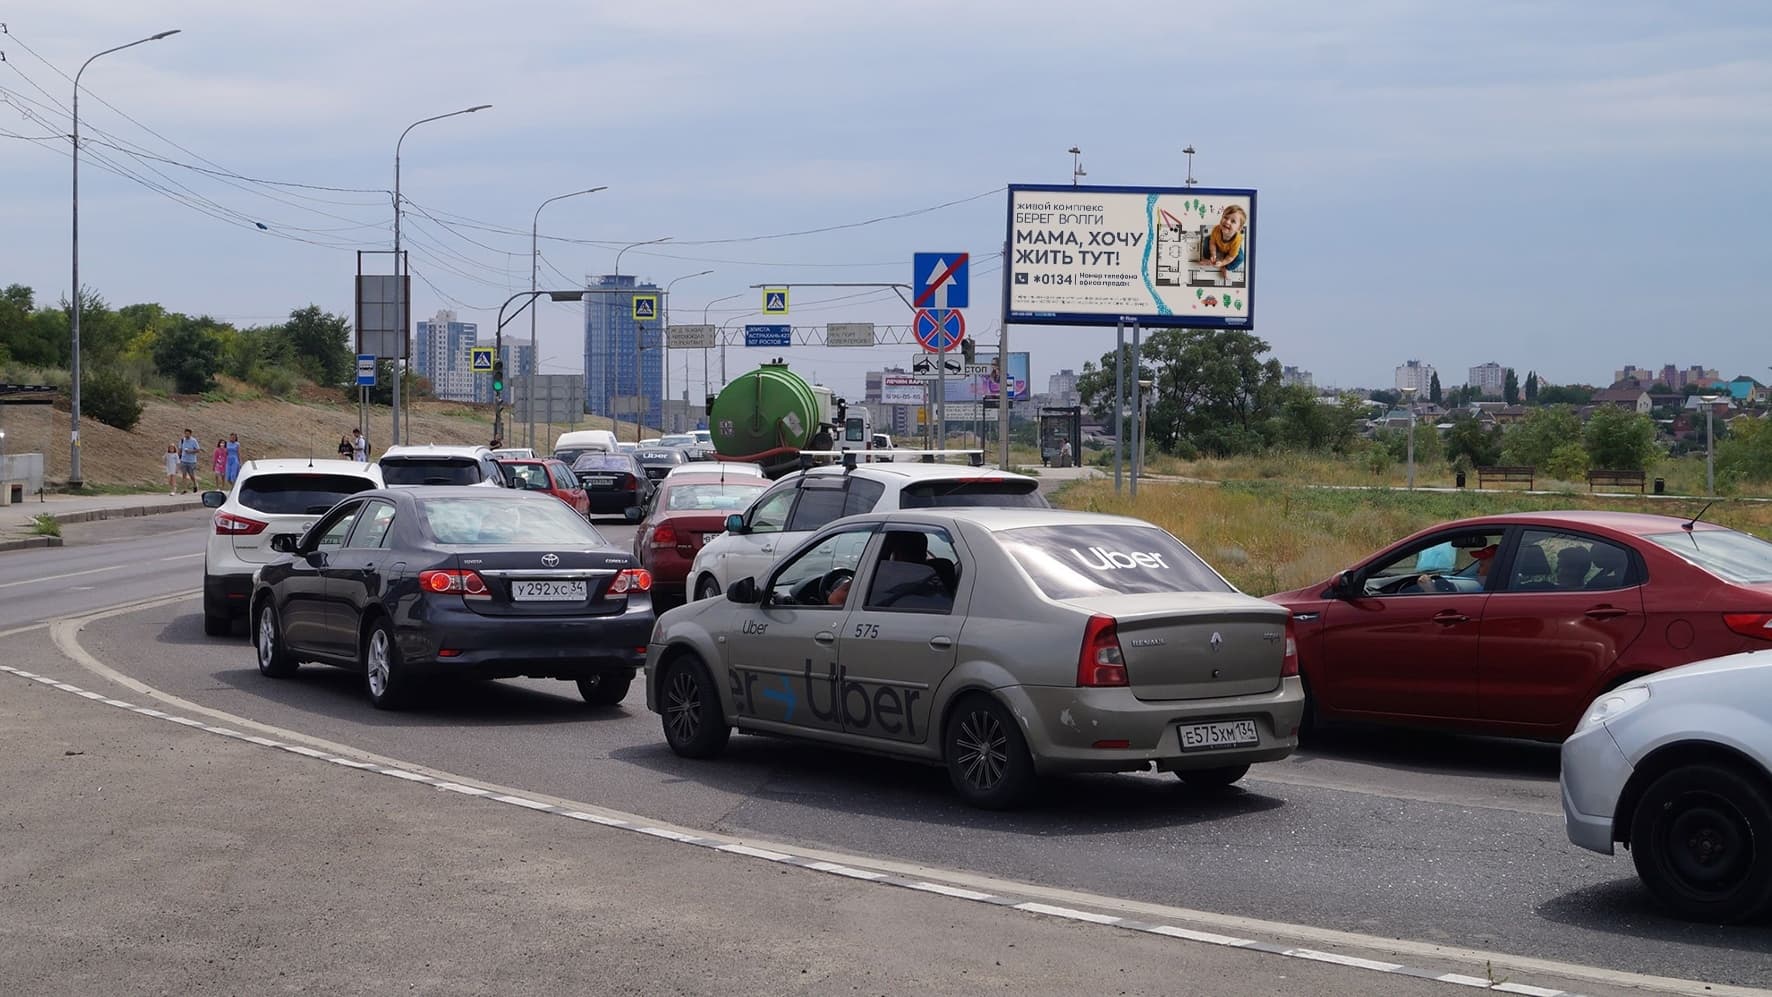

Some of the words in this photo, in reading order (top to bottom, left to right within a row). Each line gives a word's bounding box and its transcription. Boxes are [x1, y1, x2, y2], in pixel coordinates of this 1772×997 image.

[1017, 202, 1051, 211] живой
[1053, 203, 1104, 212] комплекс
[1016, 212, 1055, 224] БЕРЕГ
[1059, 213, 1104, 225] ВОЛГИ
[1016, 230, 1084, 249] МАМА,
[1087, 231, 1144, 247] ХОЧУ
[1015, 249, 1074, 265] ЖИТЬ
[1078, 250, 1121, 266] ТУТ!
[1070, 547, 1169, 570] Uber
[742, 619, 769, 635] Uber
[855, 623, 880, 639] 575
[805, 657, 922, 737] Uber
